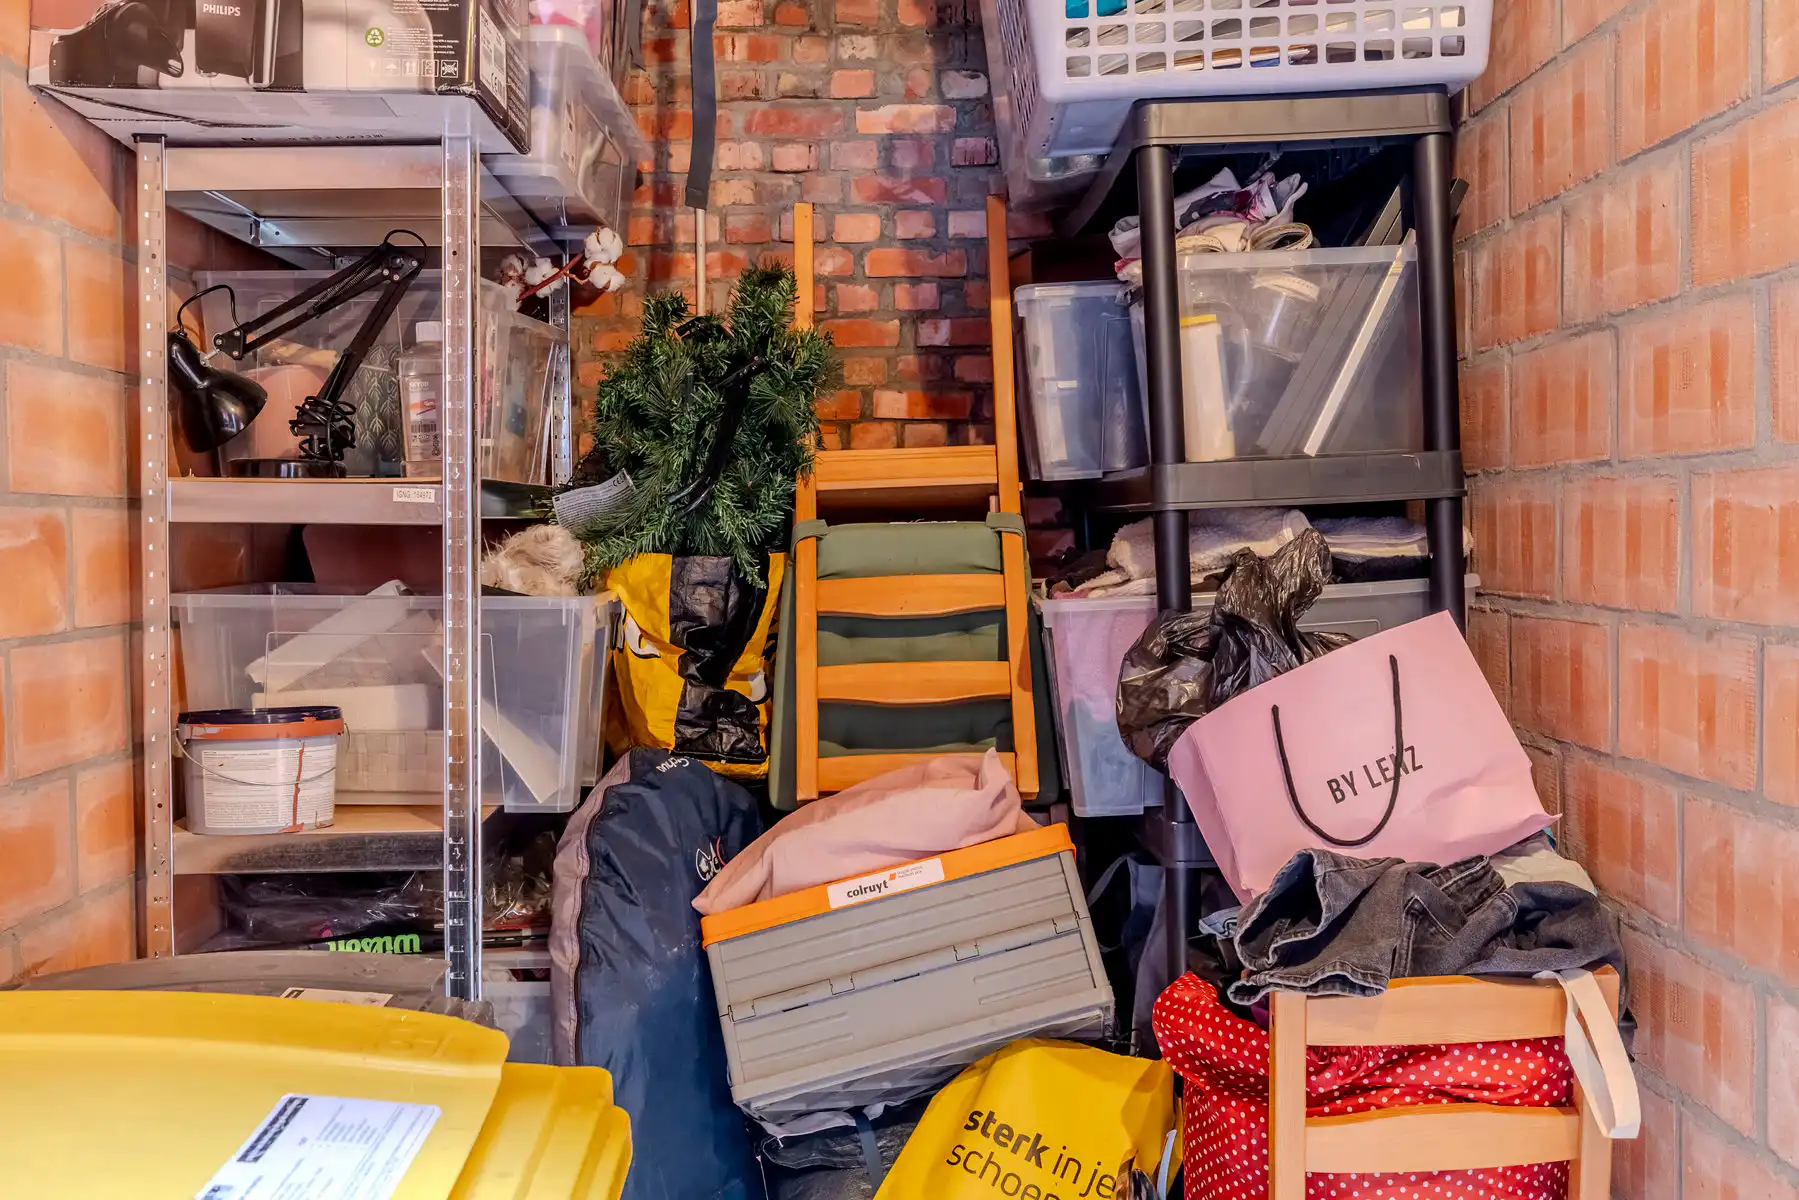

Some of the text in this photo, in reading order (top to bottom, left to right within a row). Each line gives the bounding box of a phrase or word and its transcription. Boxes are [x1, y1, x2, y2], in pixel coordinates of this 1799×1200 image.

[203, 3, 241, 17] PHILIPS
[1326, 745, 1423, 804] BY LENZ
[846, 880, 889, 898] colruyt
[963, 1110, 1117, 1199] sterk in je
